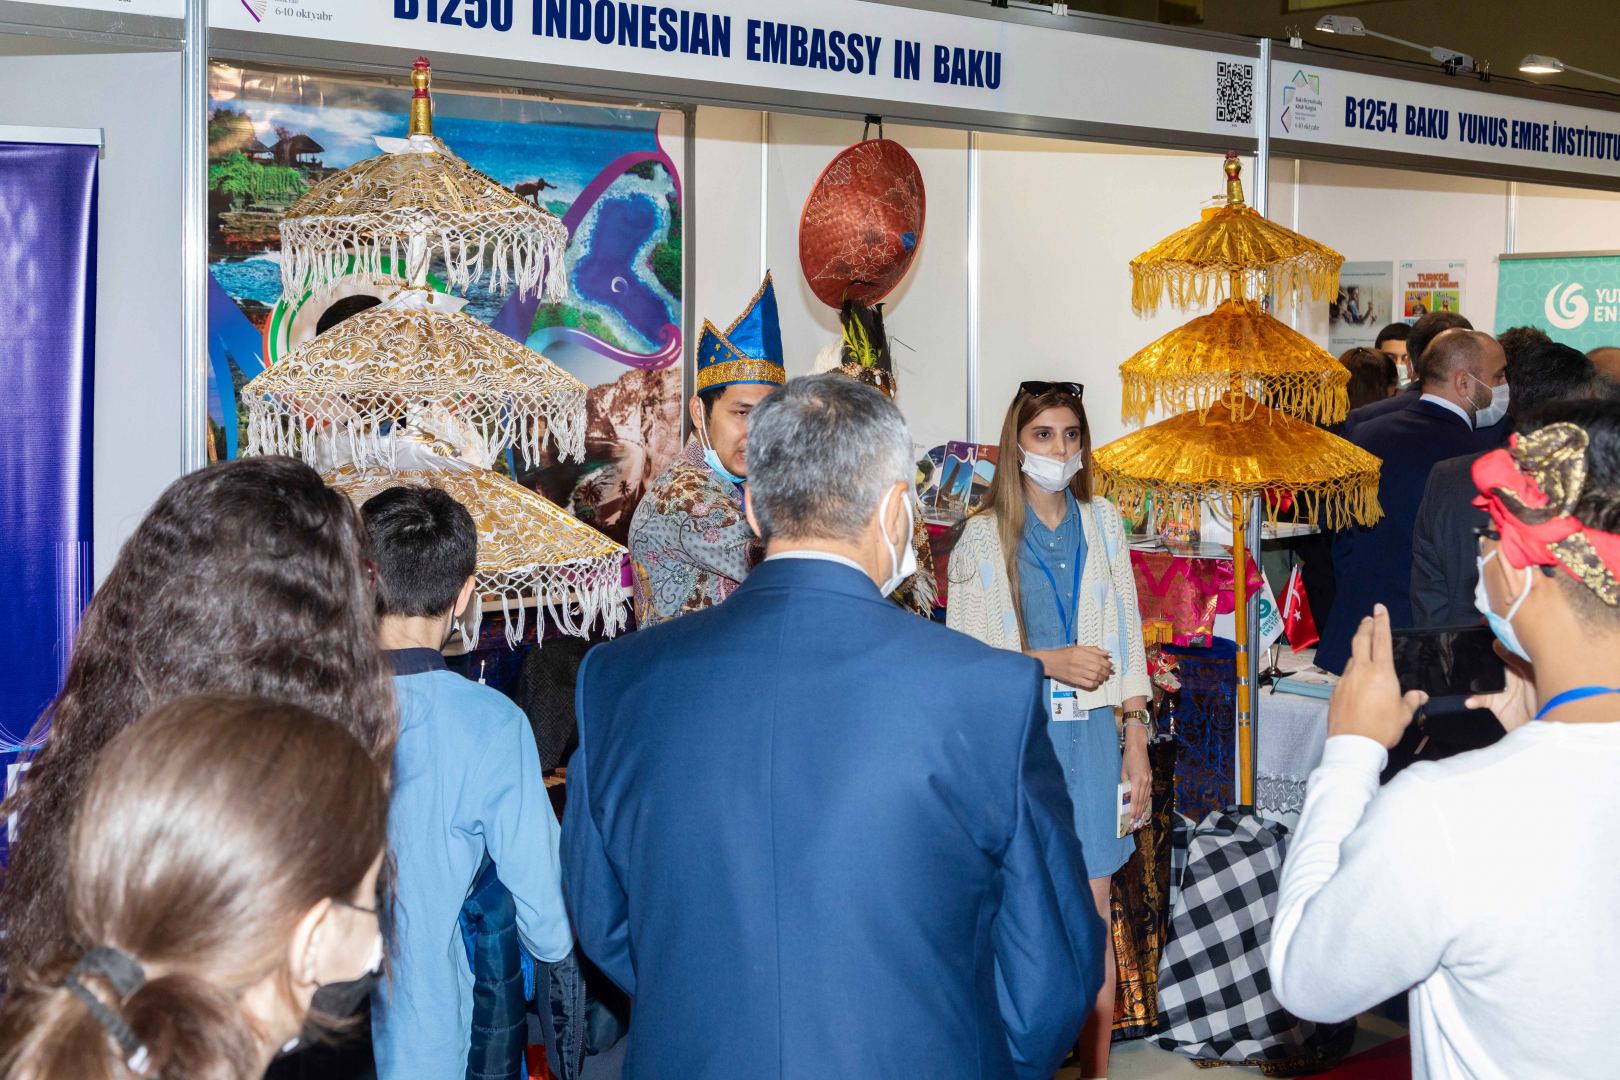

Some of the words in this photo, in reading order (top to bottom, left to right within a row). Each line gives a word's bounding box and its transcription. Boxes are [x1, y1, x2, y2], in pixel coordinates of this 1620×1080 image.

[296, 9, 333, 21] oktyabr
[532, 0, 731, 58] INDONESIAN
[746, 18, 881, 76] EMBASSY
[894, 39, 920, 81] IN
[934, 44, 1001, 90] BAKU
[1346, 96, 1398, 133] B1254
[1405, 104, 1449, 140] BAKU
[1458, 112, 1508, 148] YUNUS
[1511, 120, 1549, 152] EMRE
[1594, 306, 1620, 322] EN
